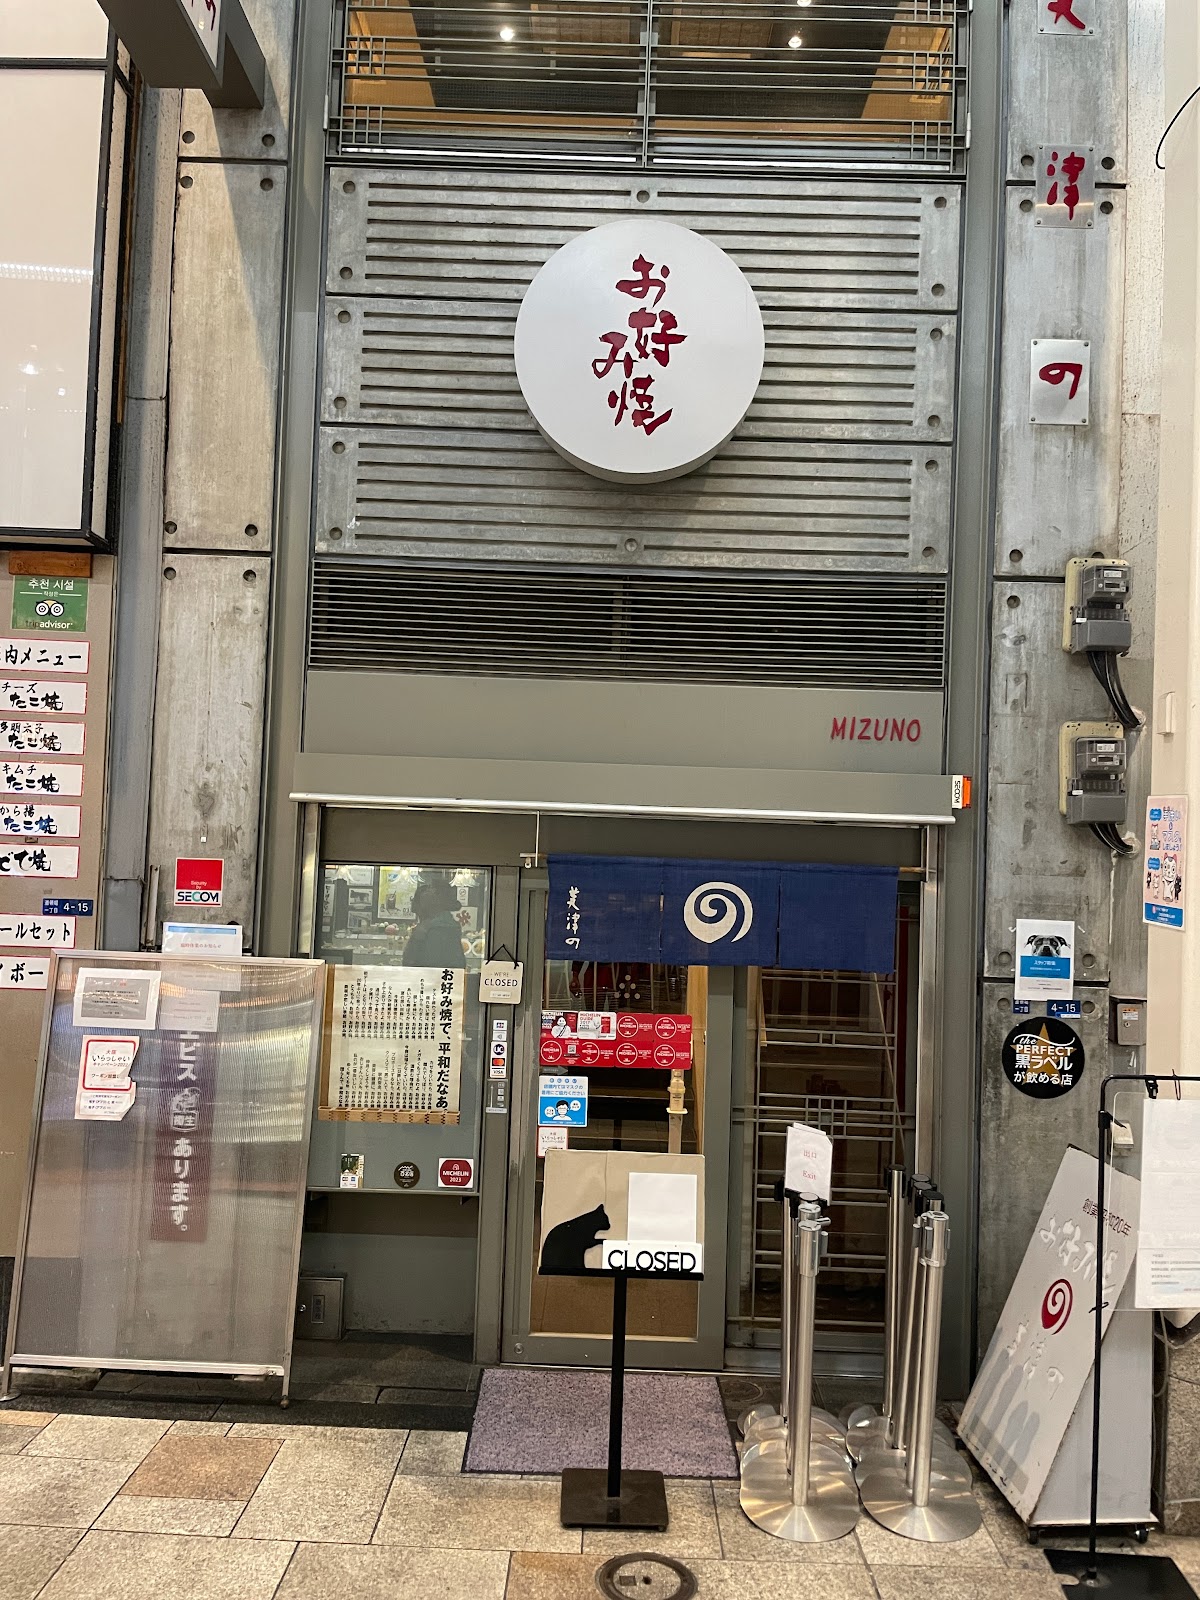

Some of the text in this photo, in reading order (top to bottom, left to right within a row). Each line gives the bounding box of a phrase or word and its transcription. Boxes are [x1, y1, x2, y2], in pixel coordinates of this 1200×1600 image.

[591, 253, 689, 437] お好み焼
[28, 578, 74, 591] 추천 시설
[26, 620, 73, 629] tripadvisor
[1, 682, 38, 694] チーズ
[9, 691, 64, 711] たこ焼
[831, 716, 922, 742] MIZUNO
[8, 732, 62, 751] たこ焼
[2, 763, 37, 775] キムチ
[6, 773, 60, 793] たこ焼
[3, 814, 58, 834] たこ焼
[177, 891, 219, 902] SECOM
[63, 902, 89, 912] 4-15
[566, 886, 580, 949] 美津の
[0, 962, 43, 983] ボー
[484, 978, 518, 987] CLOSED
[1051, 1003, 1076, 1012] 4-15
[1019, 1035, 1037, 1044] the
[1016, 1044, 1074, 1056] PERFECT
[1015, 1054, 1073, 1071] 黒ラベル
[1013, 1071, 1073, 1086] が飲める店
[802, 1170, 817, 1180] Exit
[169, 1136, 193, 1232] あります。
[607, 1249, 696, 1272] CLOSED
